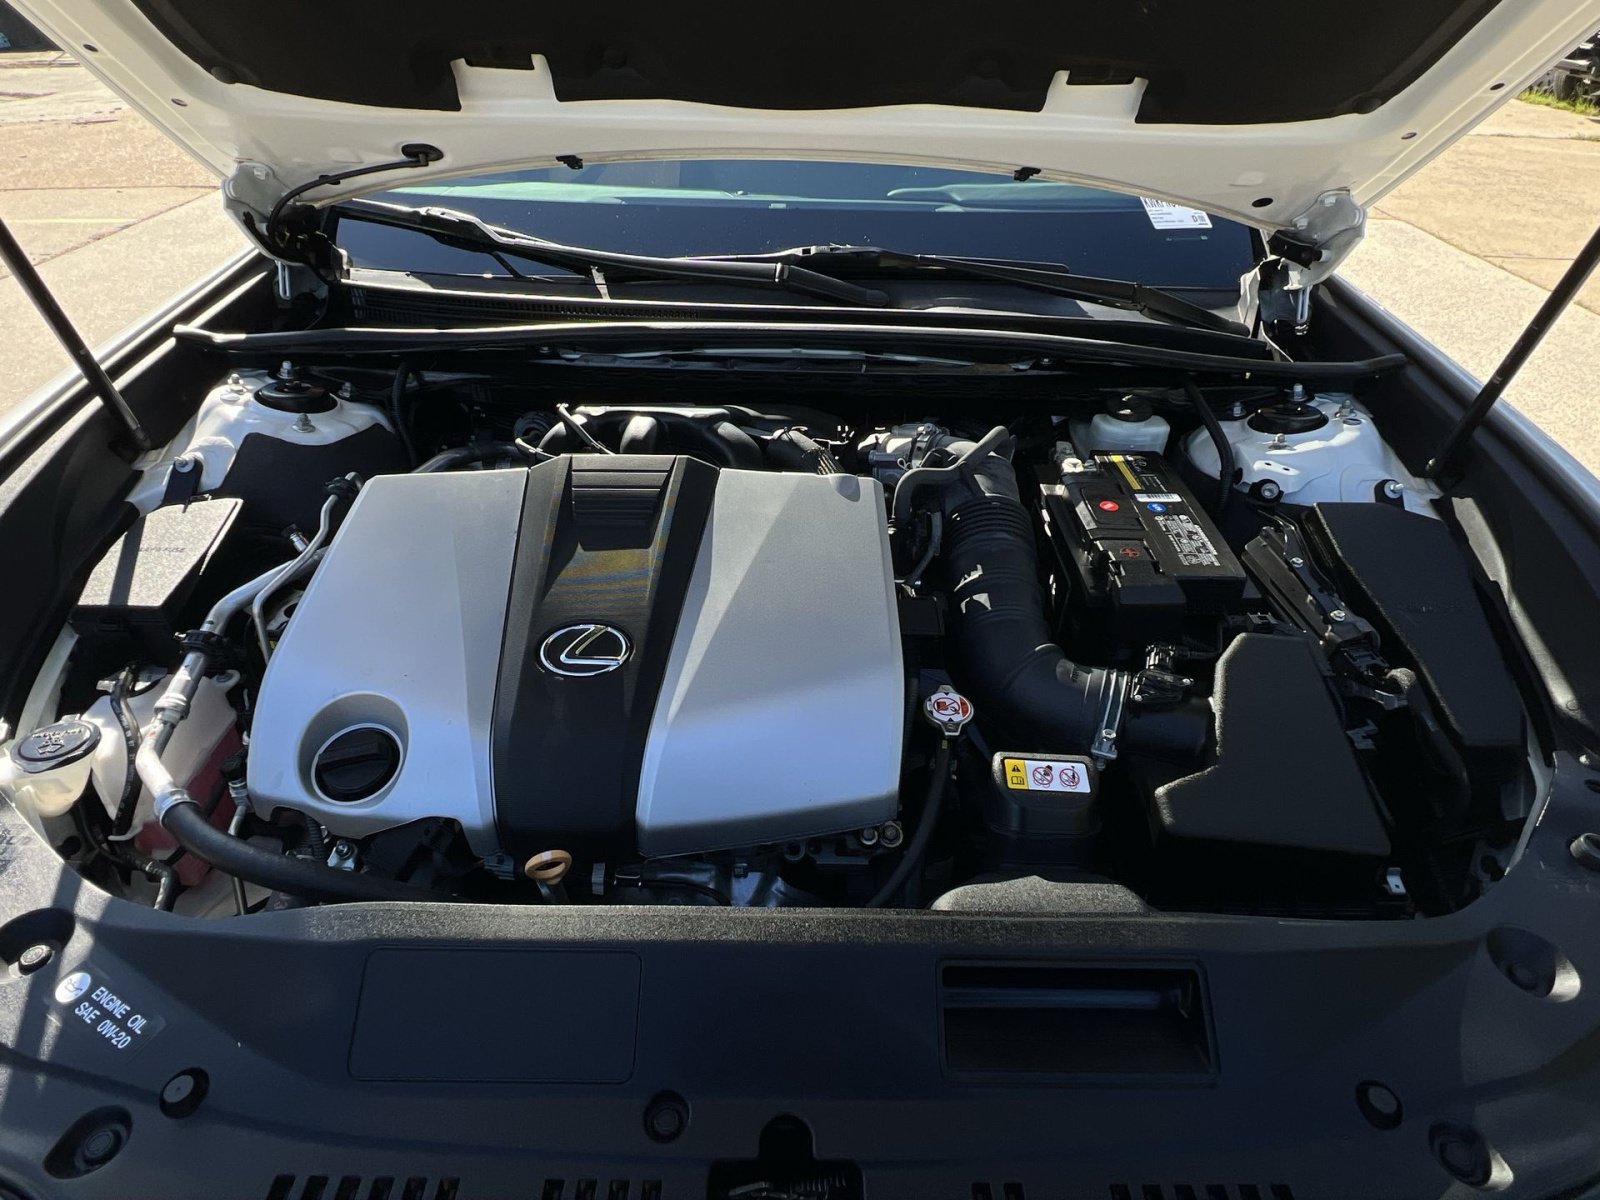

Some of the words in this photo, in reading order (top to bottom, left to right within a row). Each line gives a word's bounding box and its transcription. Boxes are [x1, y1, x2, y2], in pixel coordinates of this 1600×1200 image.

[74, 1001, 101, 1024] SAE
[96, 1019, 132, 1049] 0W-20
[91, 986, 131, 1019] ENGINE
[127, 1014, 147, 1034] OIL
